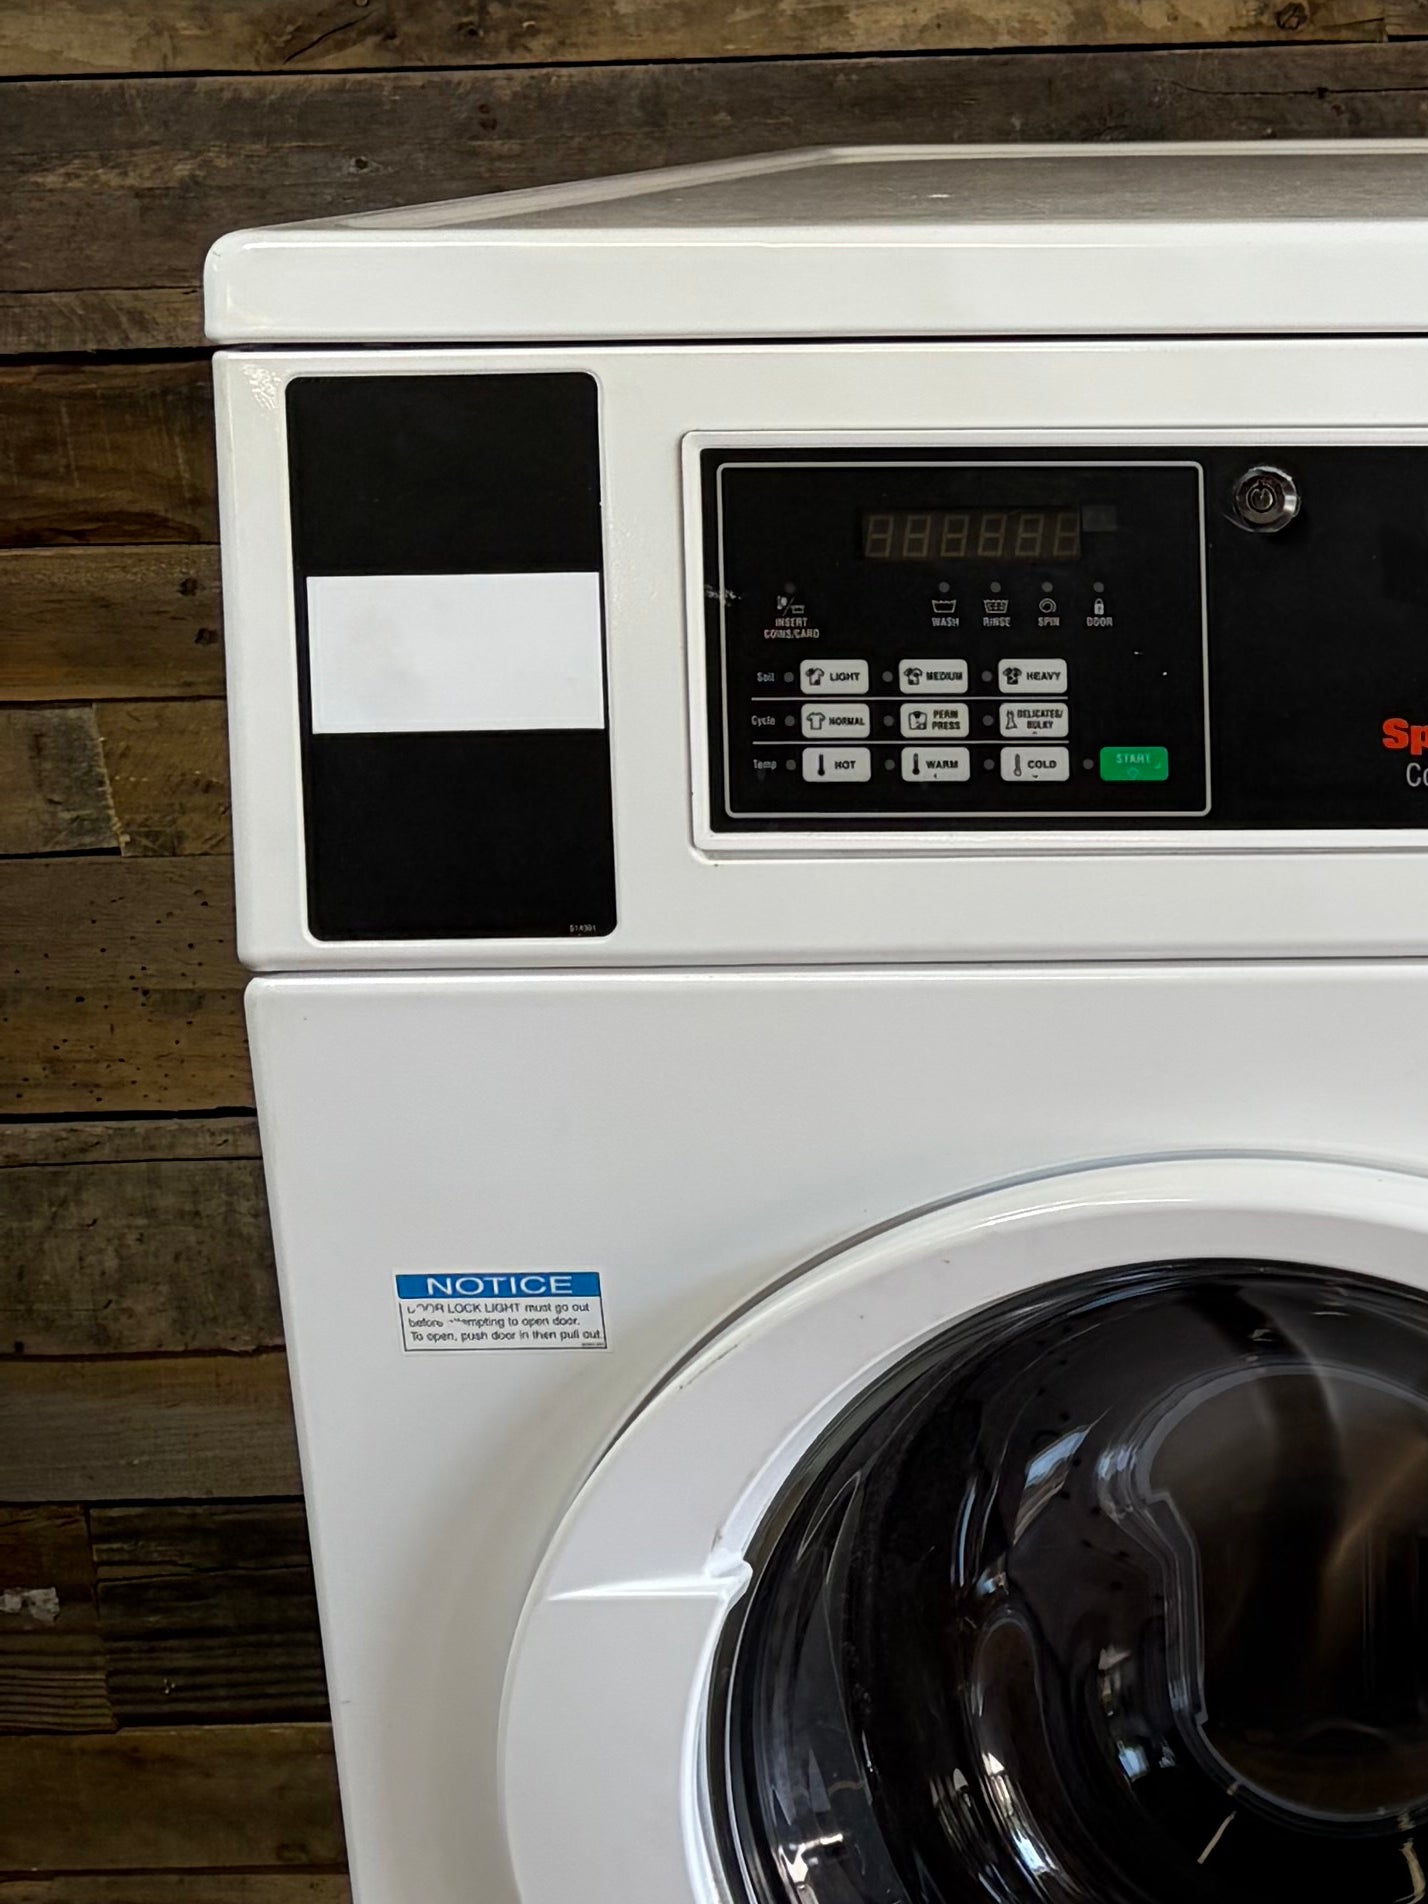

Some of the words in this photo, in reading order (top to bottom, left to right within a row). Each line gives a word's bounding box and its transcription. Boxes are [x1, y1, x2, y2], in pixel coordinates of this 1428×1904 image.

[426, 1275, 573, 1296] NOTICE
[447, 1303, 482, 1314] LOCK
[484, 1302, 521, 1314] LIGHT
[524, 1303, 552, 1313] must
[554, 1303, 569, 1315] go
[571, 1302, 590, 1312] out
[507, 1317, 519, 1327] to
[521, 1317, 550, 1328] open
[409, 1331, 424, 1341] To
[460, 1330, 488, 1342] push
[490, 1330, 516, 1340] door
[519, 1329, 530, 1340] in
[531, 1329, 557, 1339] then
[559, 1329, 580, 1341] pull
